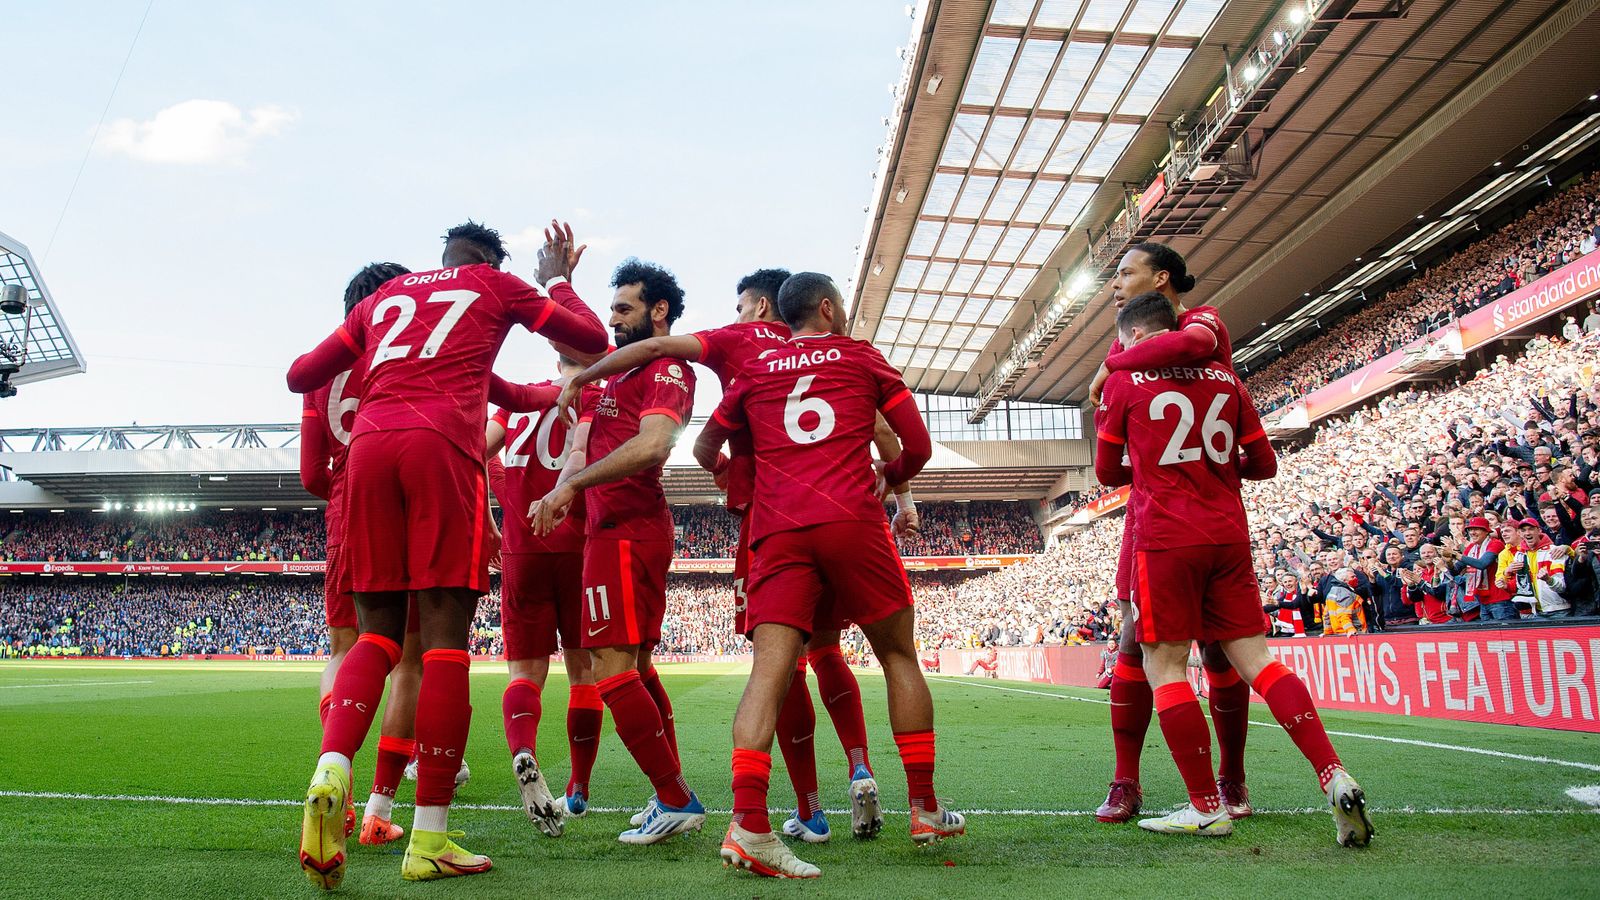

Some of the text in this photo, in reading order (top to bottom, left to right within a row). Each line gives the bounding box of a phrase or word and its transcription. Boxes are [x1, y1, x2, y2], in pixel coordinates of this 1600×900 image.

[403, 268, 459, 286] ORIGI
[1507, 272, 1576, 322] standard
[369, 289, 481, 371] 27
[767, 348, 841, 373] THIAGO
[654, 373, 689, 393] Expedia
[1130, 367, 1236, 386] ROBERTSON
[784, 374, 836, 445] 6
[505, 405, 578, 470] 20
[1149, 391, 1234, 466] 26
[51, 564, 74, 572] Expedia
[290, 563, 319, 571] standard
[586, 585, 610, 622] 11
